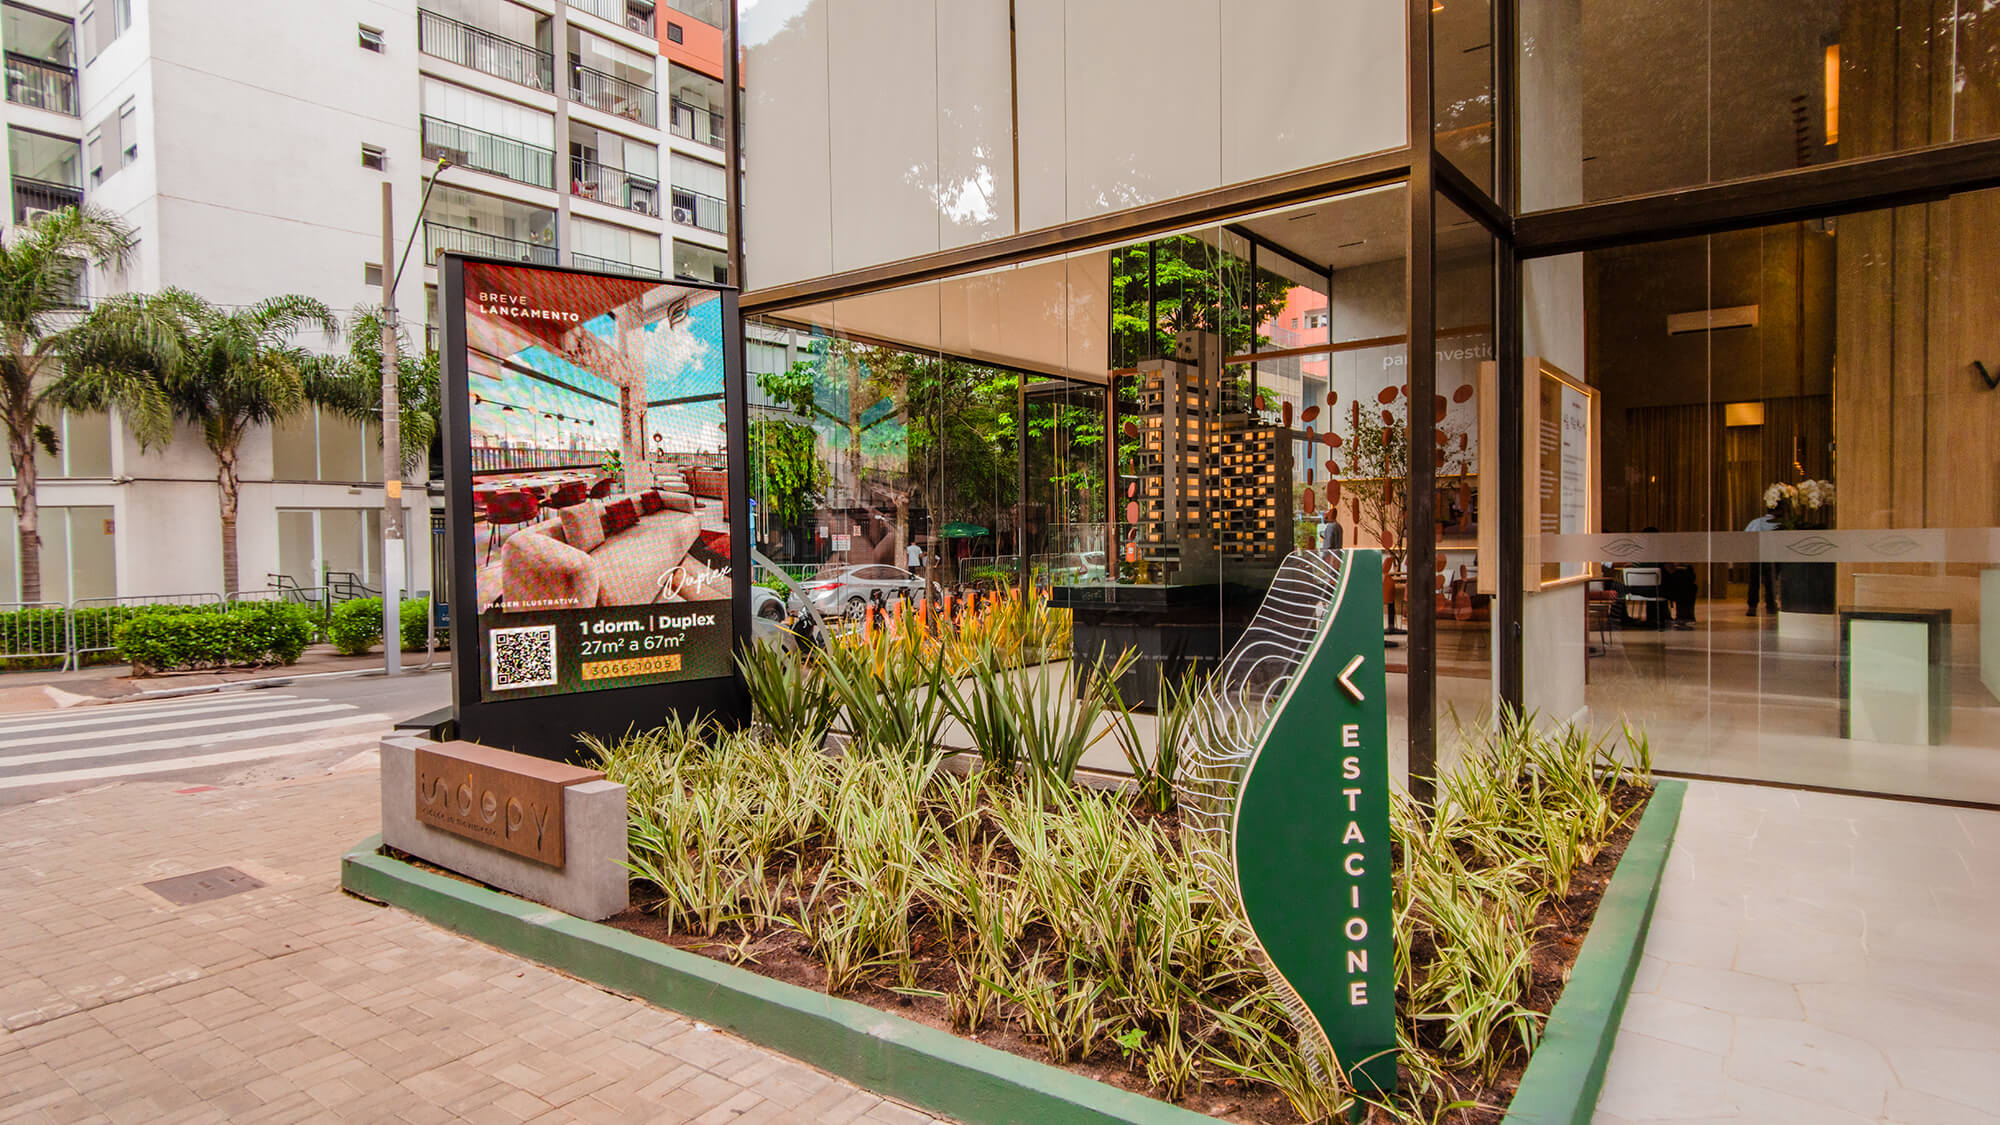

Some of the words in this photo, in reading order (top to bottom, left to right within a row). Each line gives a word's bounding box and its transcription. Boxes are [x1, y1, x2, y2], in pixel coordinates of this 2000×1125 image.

[480, 292, 527, 305] BREVE
[480, 304, 579, 322] LANÇAMENTO
[657, 559, 732, 600] Duplex
[483, 600, 519, 609] IMAGEM
[522, 597, 579, 607] ILUSTRATIVA
[579, 621, 588, 635] 1
[592, 619, 645, 634] dorm.
[659, 613, 715, 630] Duplex
[629, 640, 639, 651] a
[592, 660, 672, 675] 3066-1005
[1341, 724, 1368, 1006] ESTACIONE
